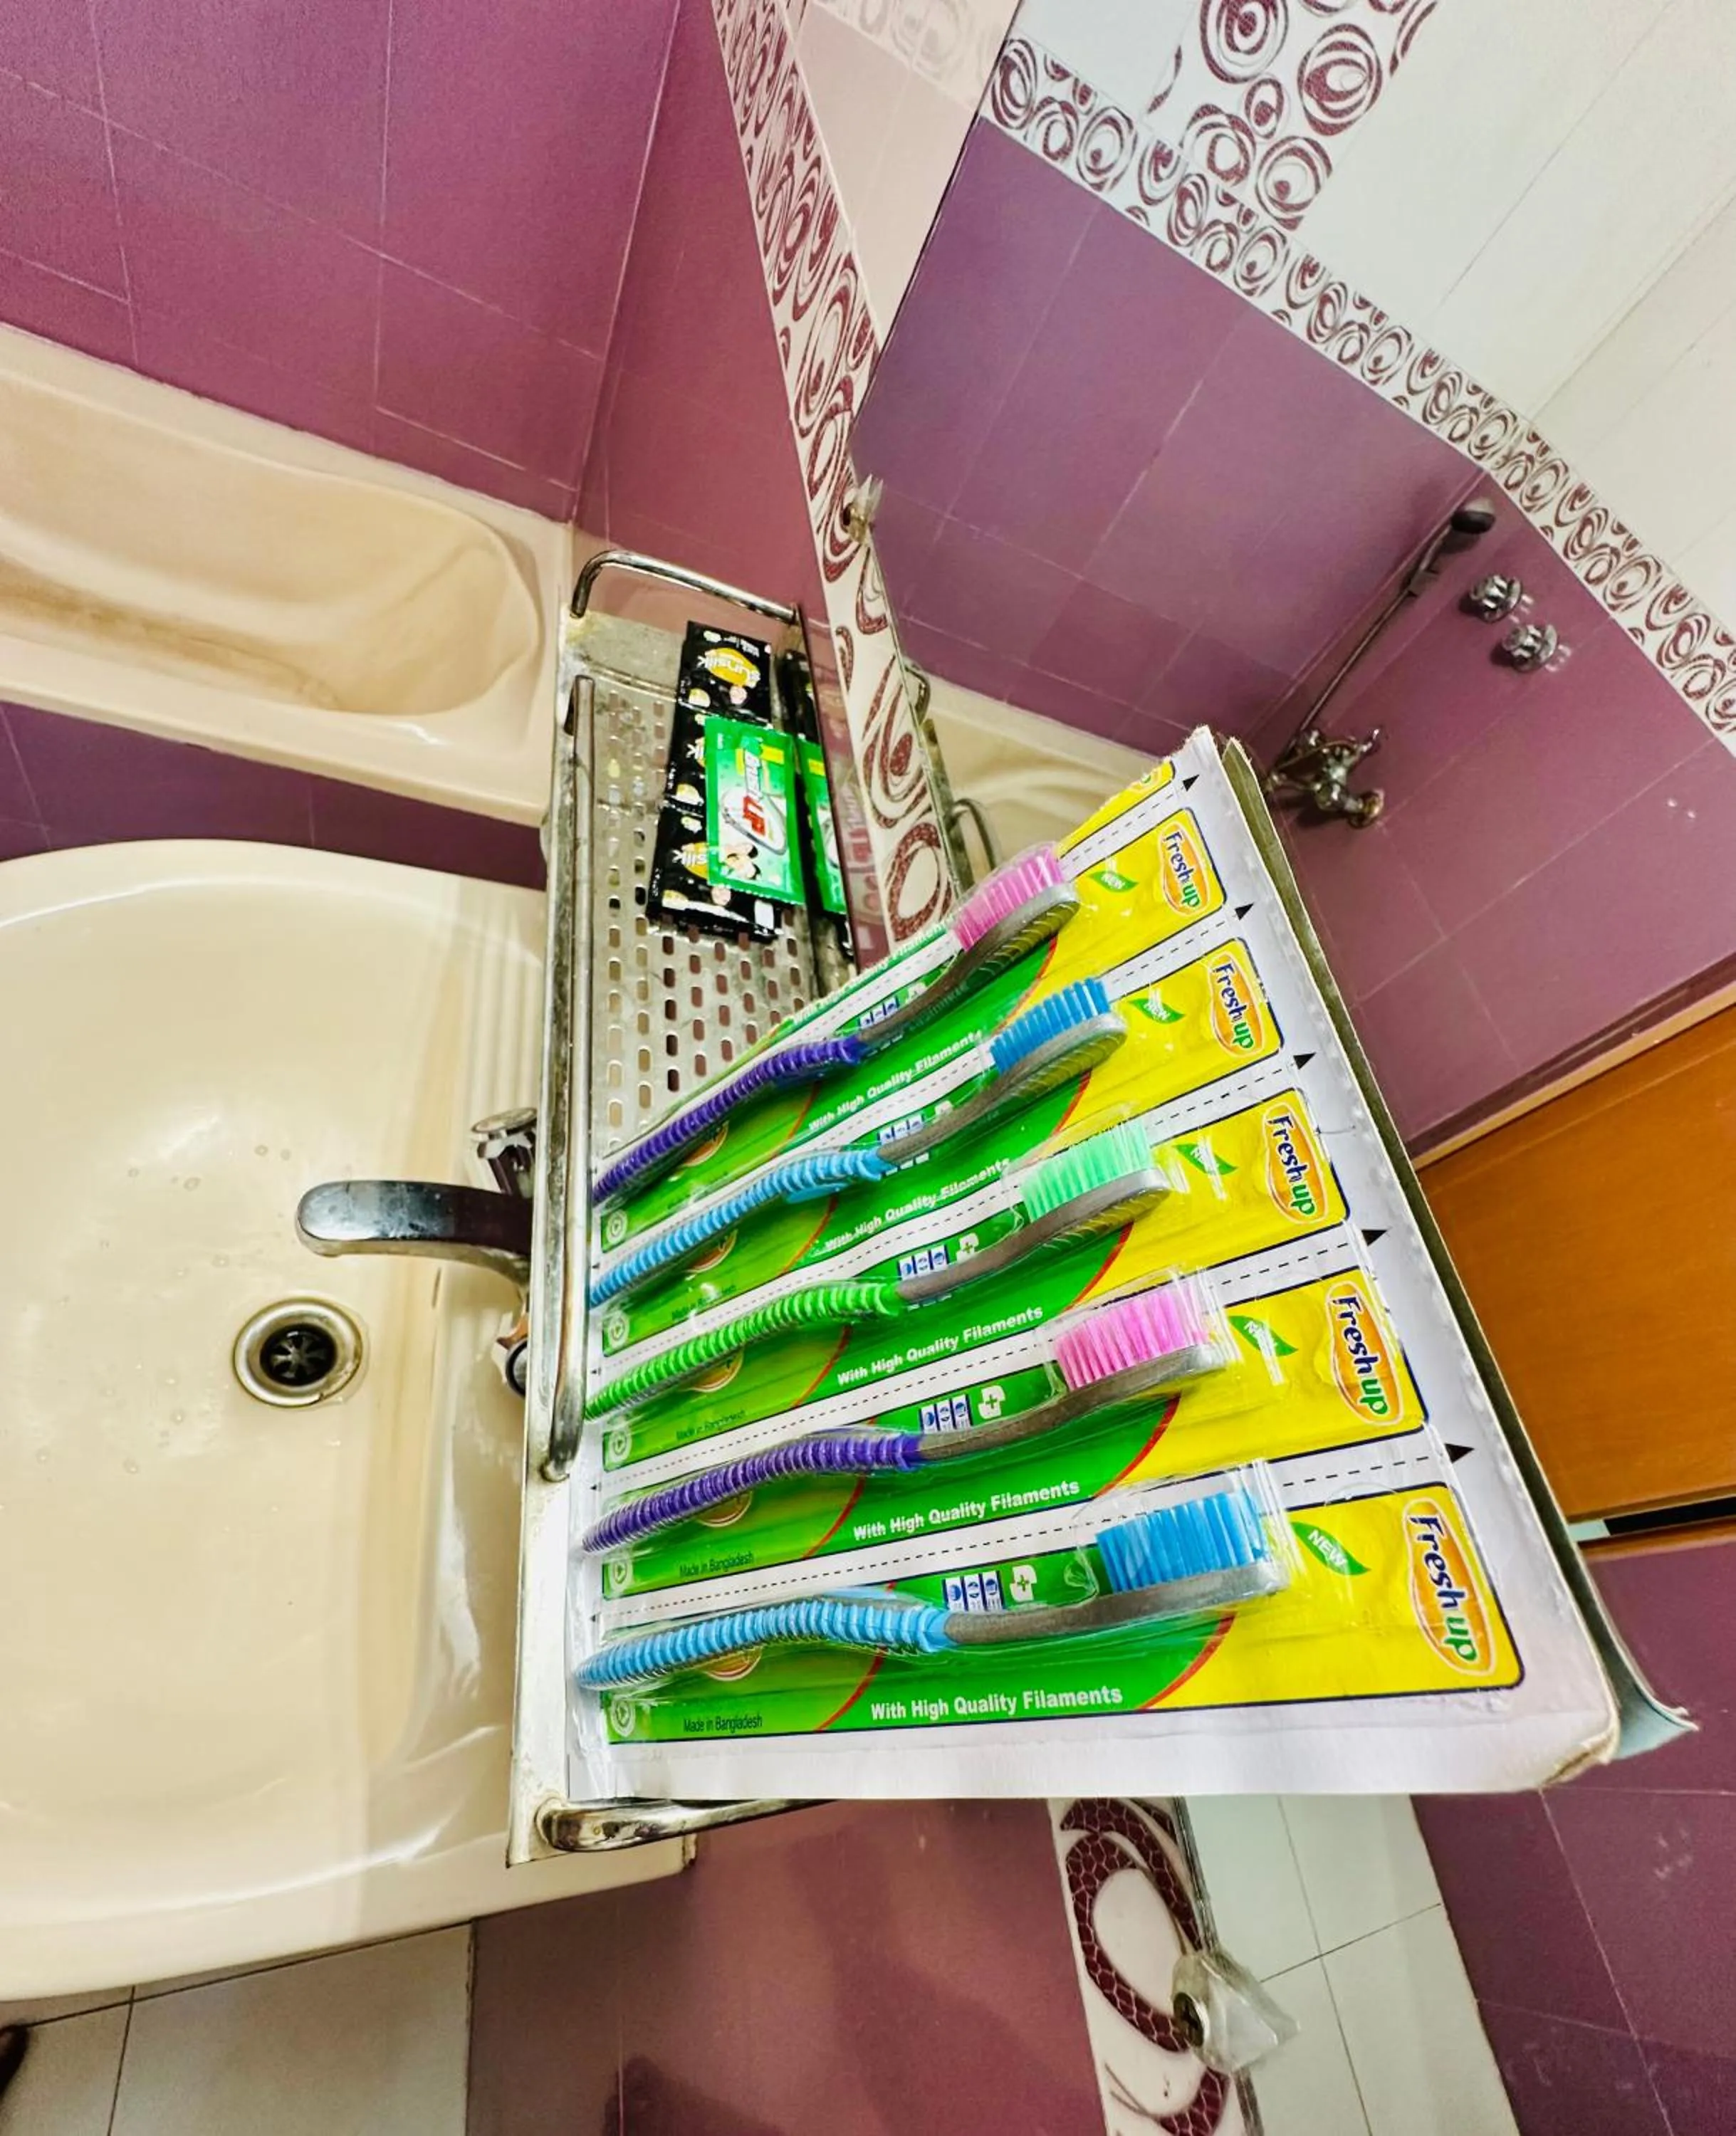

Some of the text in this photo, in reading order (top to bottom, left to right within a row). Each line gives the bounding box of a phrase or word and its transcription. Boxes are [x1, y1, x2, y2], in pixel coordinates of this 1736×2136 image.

[1164, 832, 1201, 909] Fresh up
[1212, 963, 1255, 1050] Fresh up
[1267, 1114, 1317, 1217] Fresh up
[885, 1194, 936, 1220] Quality
[837, 1307, 1043, 1386] With High Quality Filaments
[1333, 1296, 1388, 1417] Fresh up
[854, 1480, 1080, 1541] With High Quality Filaments
[1307, 1530, 1350, 1571] NEW
[1410, 1514, 1478, 1662] Fresh up
[715, 1712, 763, 1733] Bangladesh
[871, 1685, 1123, 1720] With High Quality Filaments
